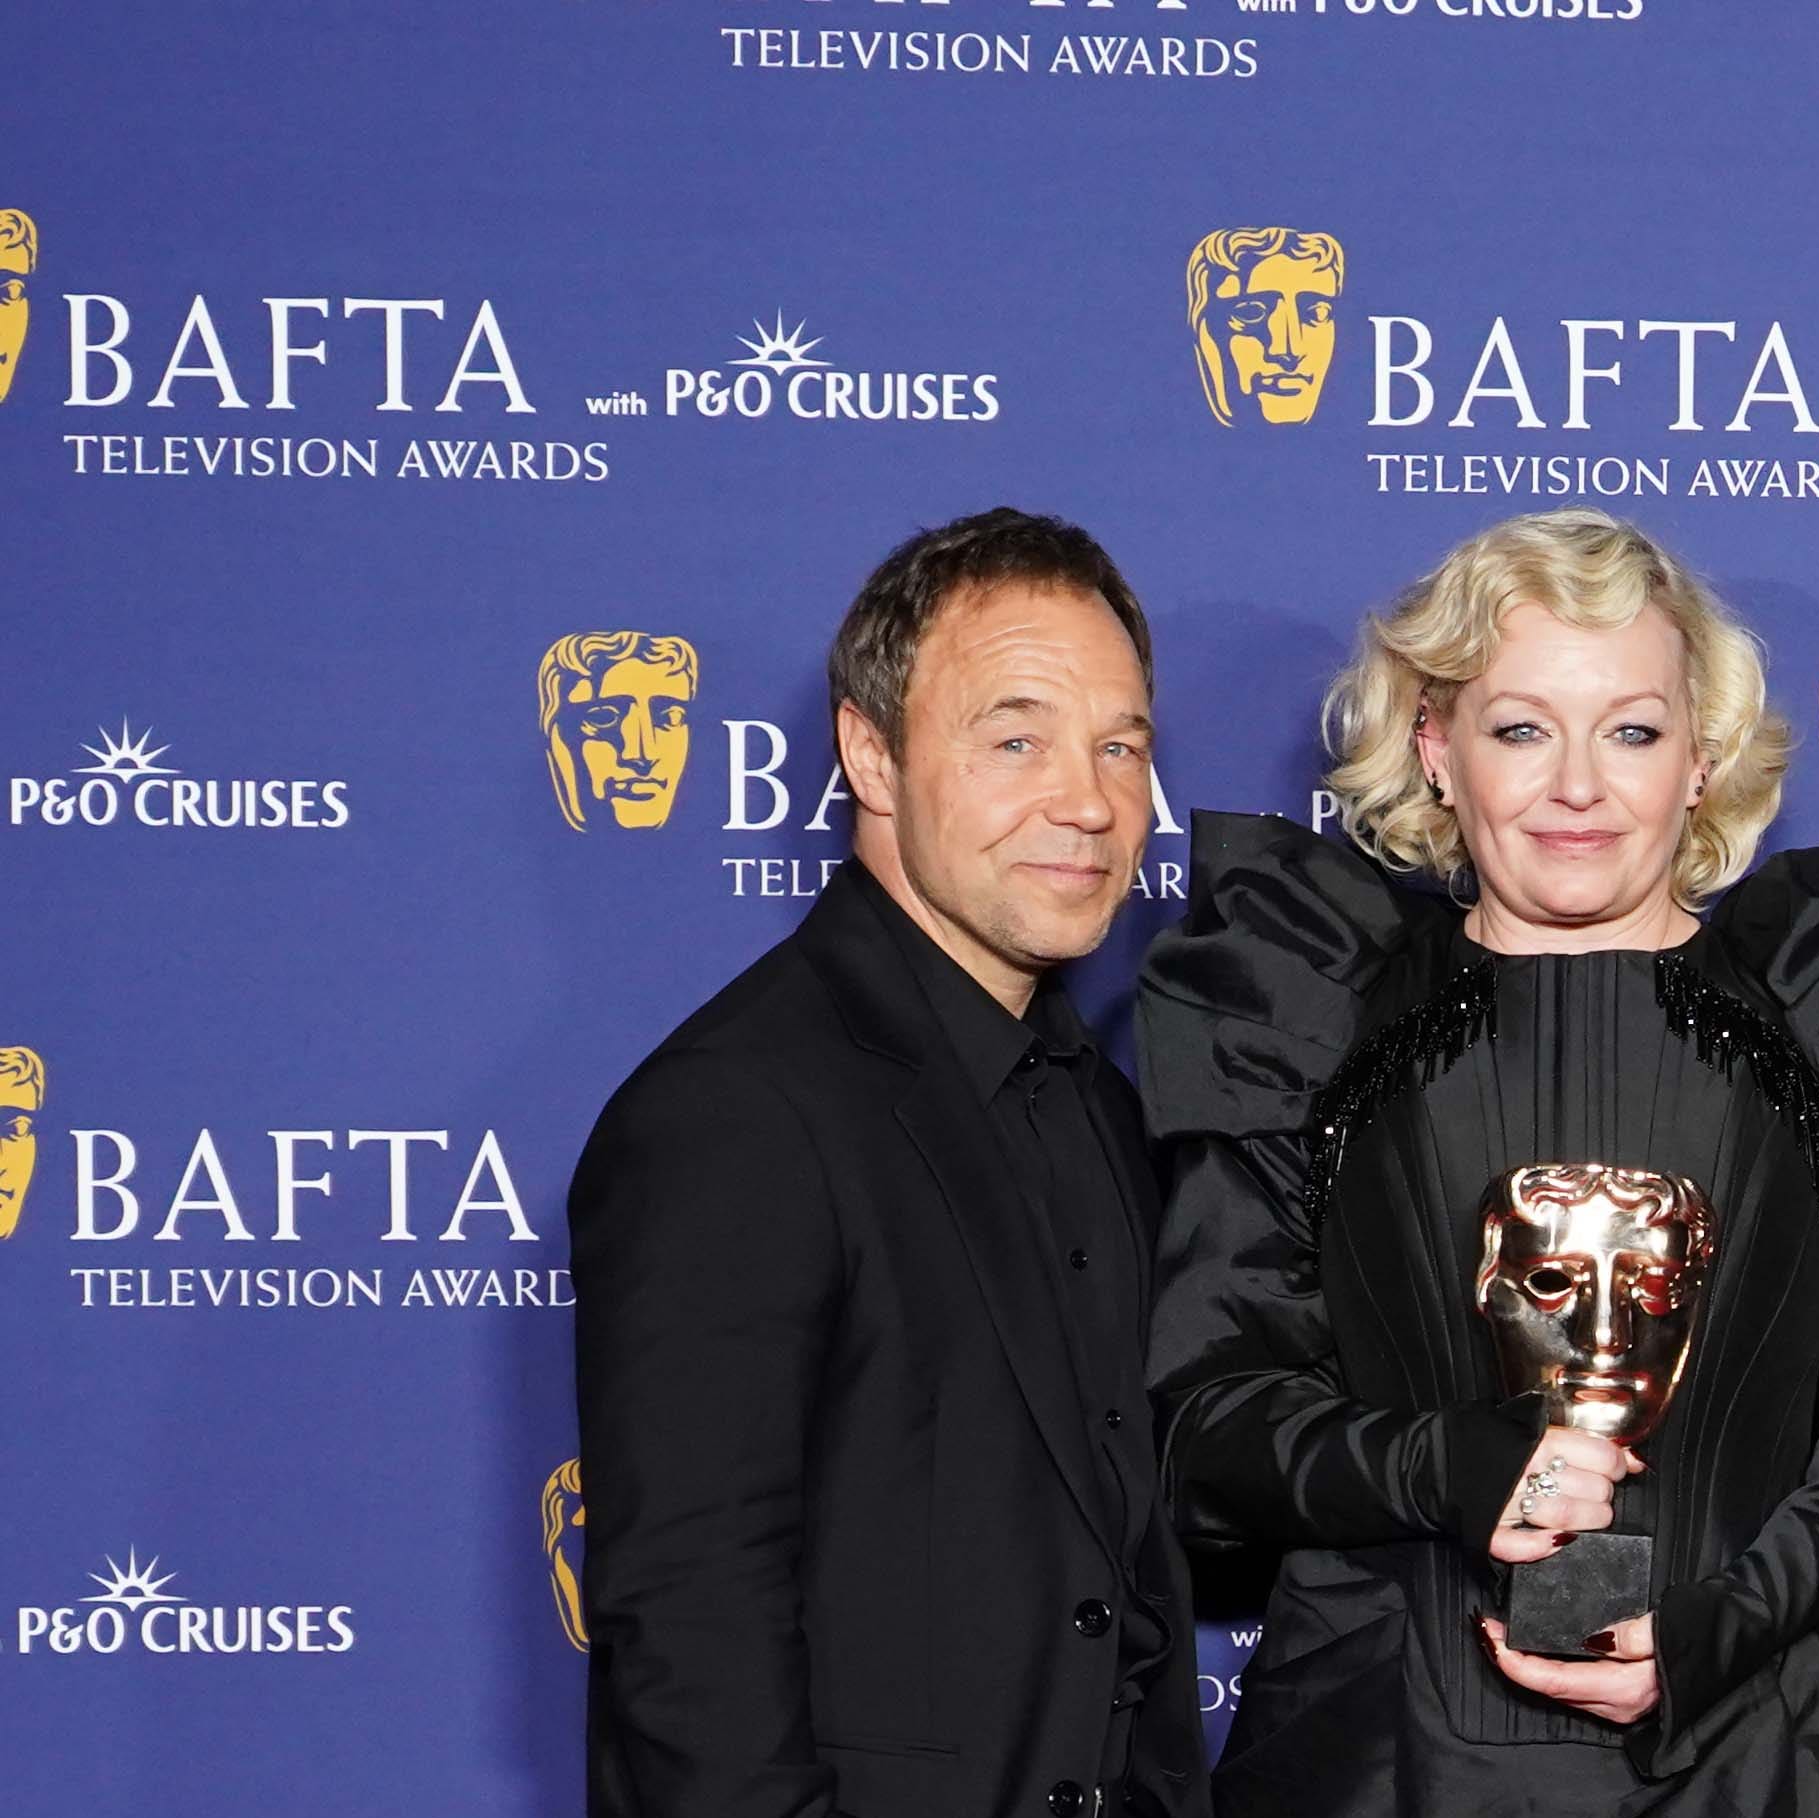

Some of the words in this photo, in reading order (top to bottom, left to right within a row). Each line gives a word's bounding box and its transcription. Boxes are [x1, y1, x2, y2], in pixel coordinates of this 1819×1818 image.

[720, 28, 1031, 72] TELEVISION
[1049, 36, 1257, 78] AWARDS
[62, 294, 537, 413] BAFTA
[585, 391, 647, 416] with
[666, 369, 772, 418] P&O
[787, 371, 999, 421] CRUISES
[63, 435, 378, 477] TELEVISION
[397, 440, 609, 481] AWARDS
[1367, 454, 1670, 496] TELEVISION
[11, 778, 118, 826] P&O
[134, 779, 349, 828] CRUISES
[69, 1128, 540, 1241] BAFTA
[70, 1268, 382, 1307] TELEVISION
[401, 1269, 576, 1307] AWARD
[18, 1607, 125, 1654] P&O
[141, 1605, 354, 1653] CRUISES
[1231, 1625, 1263, 1647] wi
